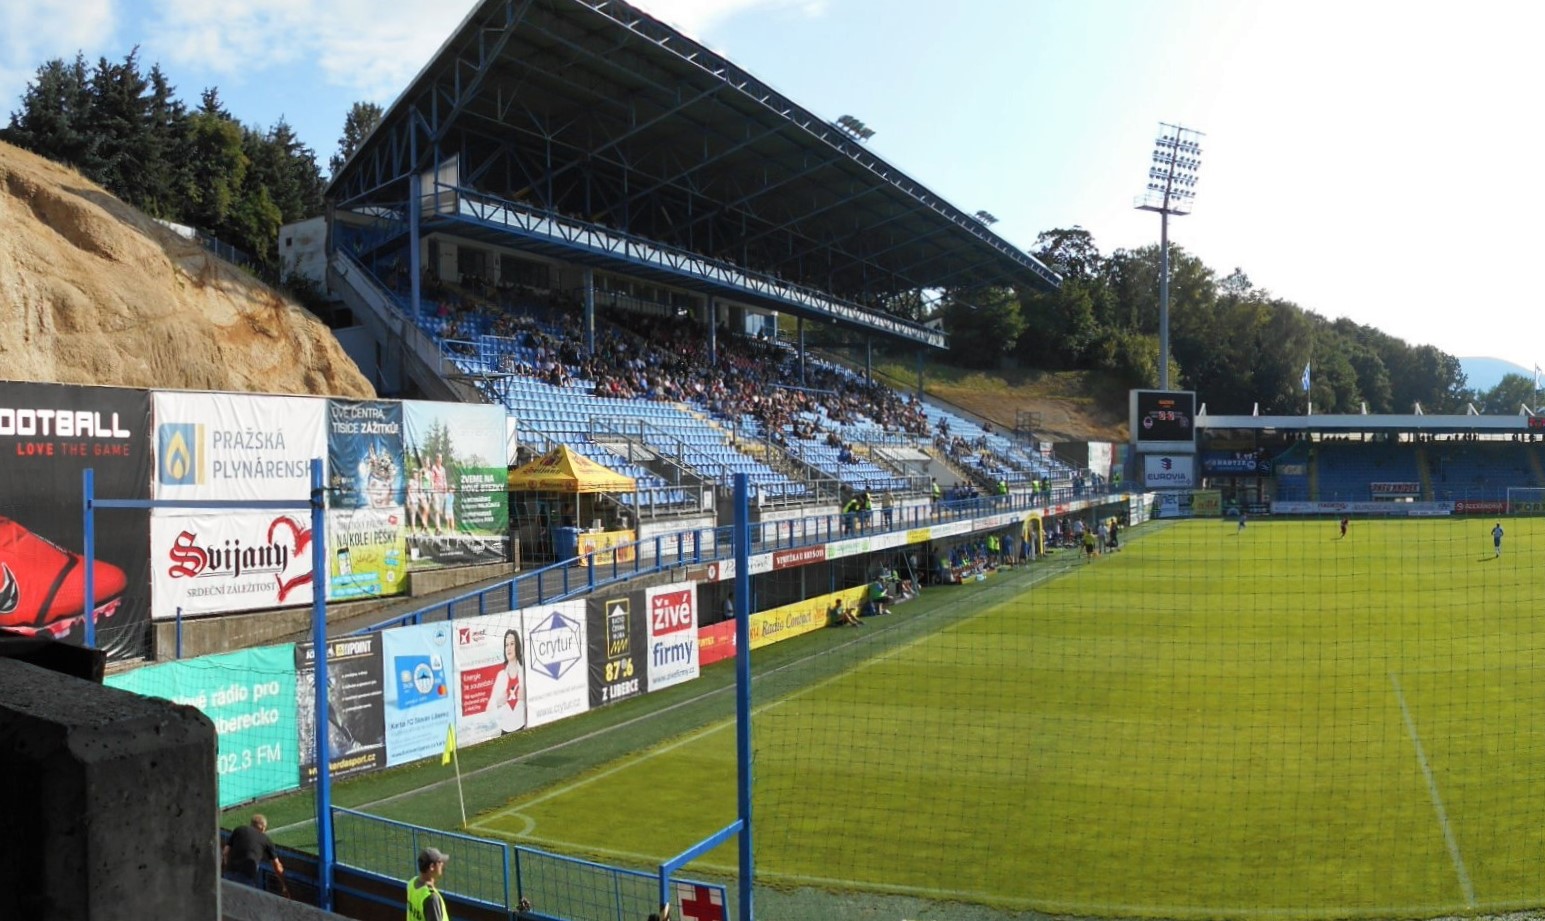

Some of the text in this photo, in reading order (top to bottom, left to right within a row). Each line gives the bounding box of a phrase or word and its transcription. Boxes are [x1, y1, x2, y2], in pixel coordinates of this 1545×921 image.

[16, 442, 131, 457] LOVE THE GAME
[212, 427, 286, 450] PRAŽSKÁ
[1147, 473, 1186, 481] EUROVIA
[349, 531, 369, 547] KOLE
[168, 530, 288, 579] Svijany
[186, 581, 276, 598] SRDEČNÍ ZÁLEŽITOST
[654, 593, 691, 631] živé
[762, 616, 785, 638] Radio
[785, 610, 812, 629] Contact
[538, 634, 574, 658] crytur
[653, 640, 694, 668] firmy
[211, 682, 248, 707] rádio
[253, 681, 280, 703] pro
[601, 686, 608, 701] Z
[609, 678, 639, 700] LIBERCE
[216, 706, 279, 735] iberecko
[217, 742, 281, 775] 02.3 FM
